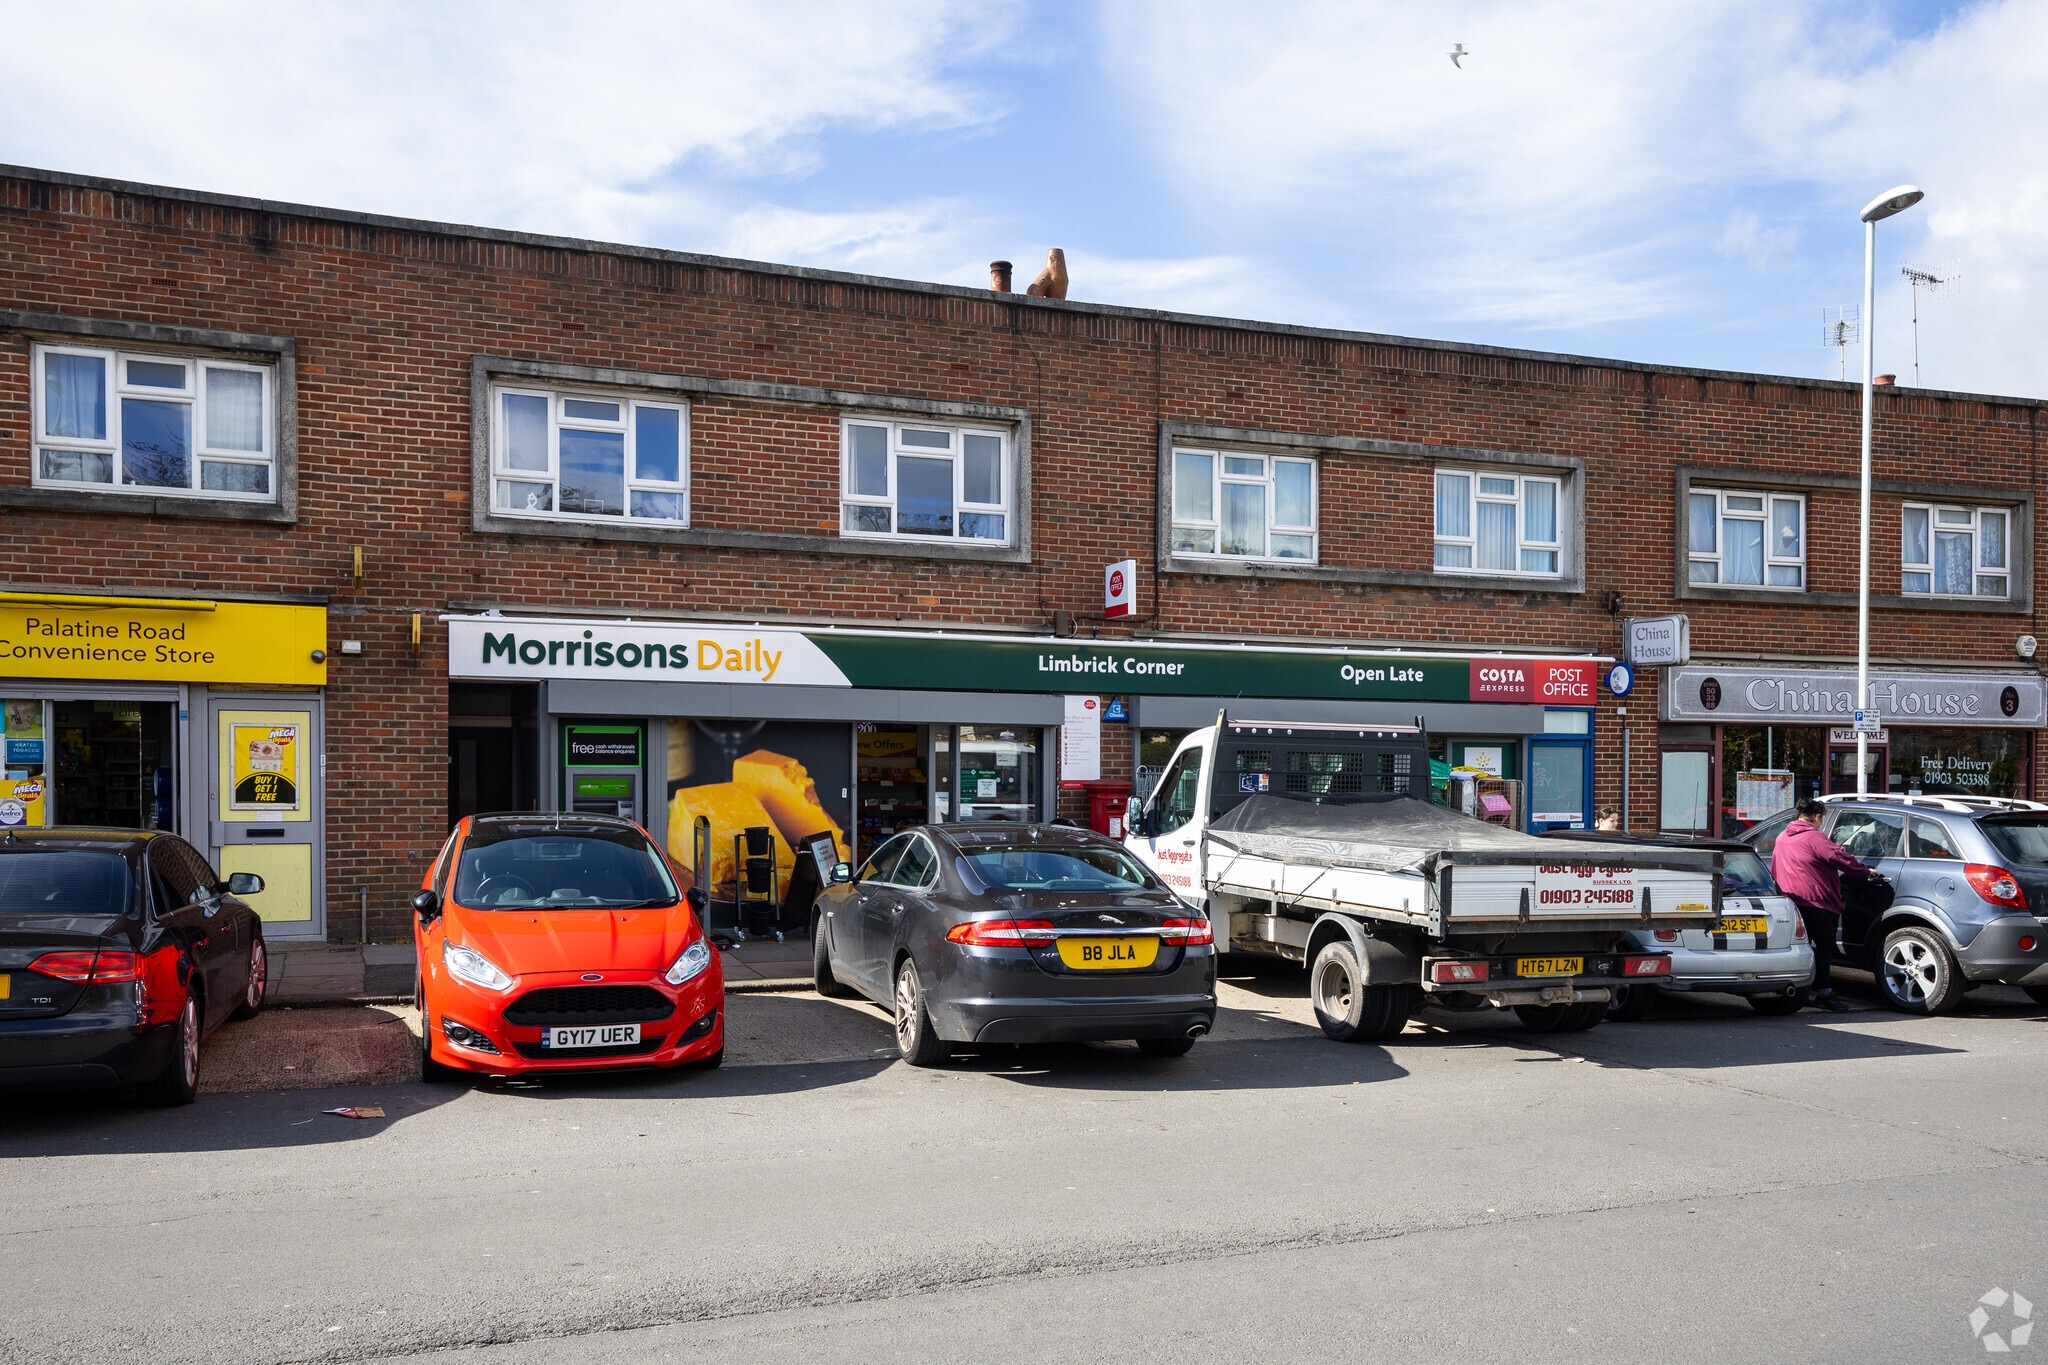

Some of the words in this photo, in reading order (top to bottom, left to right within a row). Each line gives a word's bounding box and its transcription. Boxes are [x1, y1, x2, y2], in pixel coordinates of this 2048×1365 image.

[1112, 575, 1121, 584] POST
[1110, 582, 1122, 592] OFFICE
[26, 618, 119, 638] Palatine
[128, 621, 185, 640] Road
[1635, 627, 1670, 641] China
[0, 639, 146, 661] Convenience
[155, 645, 215, 663] Store
[482, 630, 689, 669] Morrisons
[697, 638, 782, 682] Daily
[1633, 645, 1672, 658] House
[1038, 654, 1118, 673] Limbrick
[1123, 657, 1185, 675] Corner
[1340, 665, 1385, 685] Open
[1390, 666, 1424, 682] Late
[1479, 668, 1525, 683] COSTA
[1549, 668, 1583, 682] POST
[1543, 683, 1589, 697] OFFICE
[1706, 687, 1716, 695] 50
[1744, 678, 1855, 713] China
[1867, 682, 1980, 716] House
[2006, 700, 2014, 711] 3
[1857, 712, 1862, 720] P
[269, 728, 295, 739] MEGA
[1833, 731, 1885, 740] WELME
[572, 742, 595, 754] free
[873, 740, 905, 749] Offers
[1920, 756, 1944, 769] Free
[1947, 756, 1993, 774] Delivery
[254, 776, 272, 784] BUY
[1924, 772, 1952, 784] 01903
[1955, 773, 1990, 785] 503388
[13, 784, 42, 795] MEGA
[255, 784, 272, 792] GET
[255, 793, 277, 801] FREE
[1157, 849, 1167, 860] Just
[1168, 849, 1192, 864] Aggregate
[1540, 890, 1581, 903] 01903
[1584, 890, 1633, 903] 245188
[1719, 920, 1737, 930] S12
[1739, 920, 1757, 930] SFT
[1083, 945, 1102, 961] B8
[1108, 945, 1136, 960] JLA
[1521, 960, 1552, 973] HT67
[1555, 959, 1578, 972] LZN
[557, 1029, 597, 1045] GY17
[602, 1027, 635, 1043] UER
